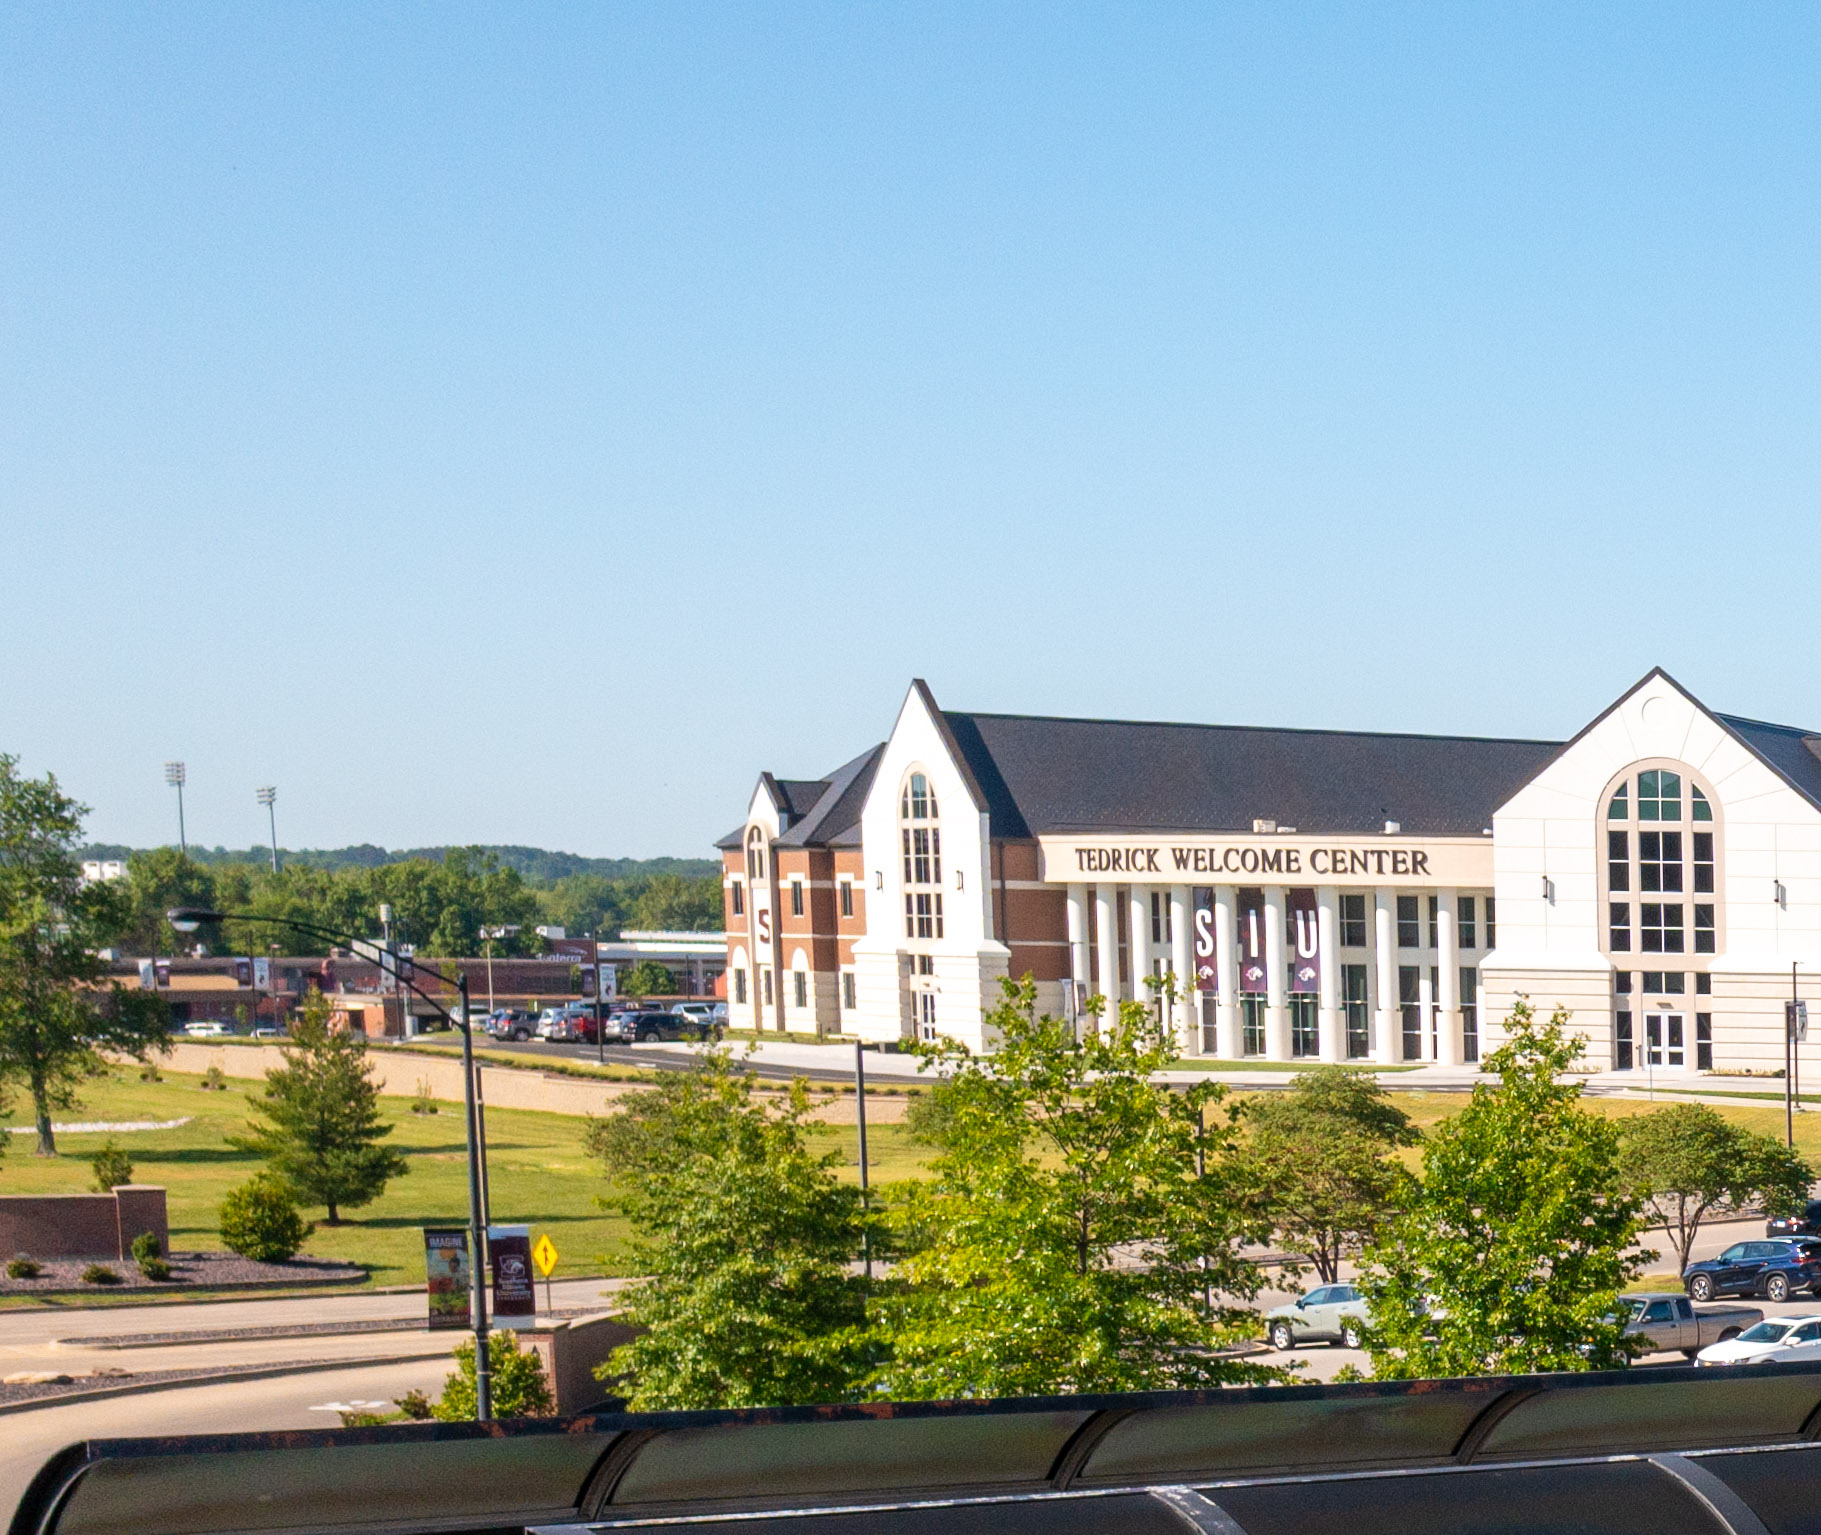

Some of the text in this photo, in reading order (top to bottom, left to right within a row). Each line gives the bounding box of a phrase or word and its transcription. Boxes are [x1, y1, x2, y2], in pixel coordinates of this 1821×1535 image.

[1074, 847, 1432, 876] TEDRICK WELCOME CENTER
[1195, 909, 1319, 960] S I U
[429, 1237, 463, 1248] IMAGINE
